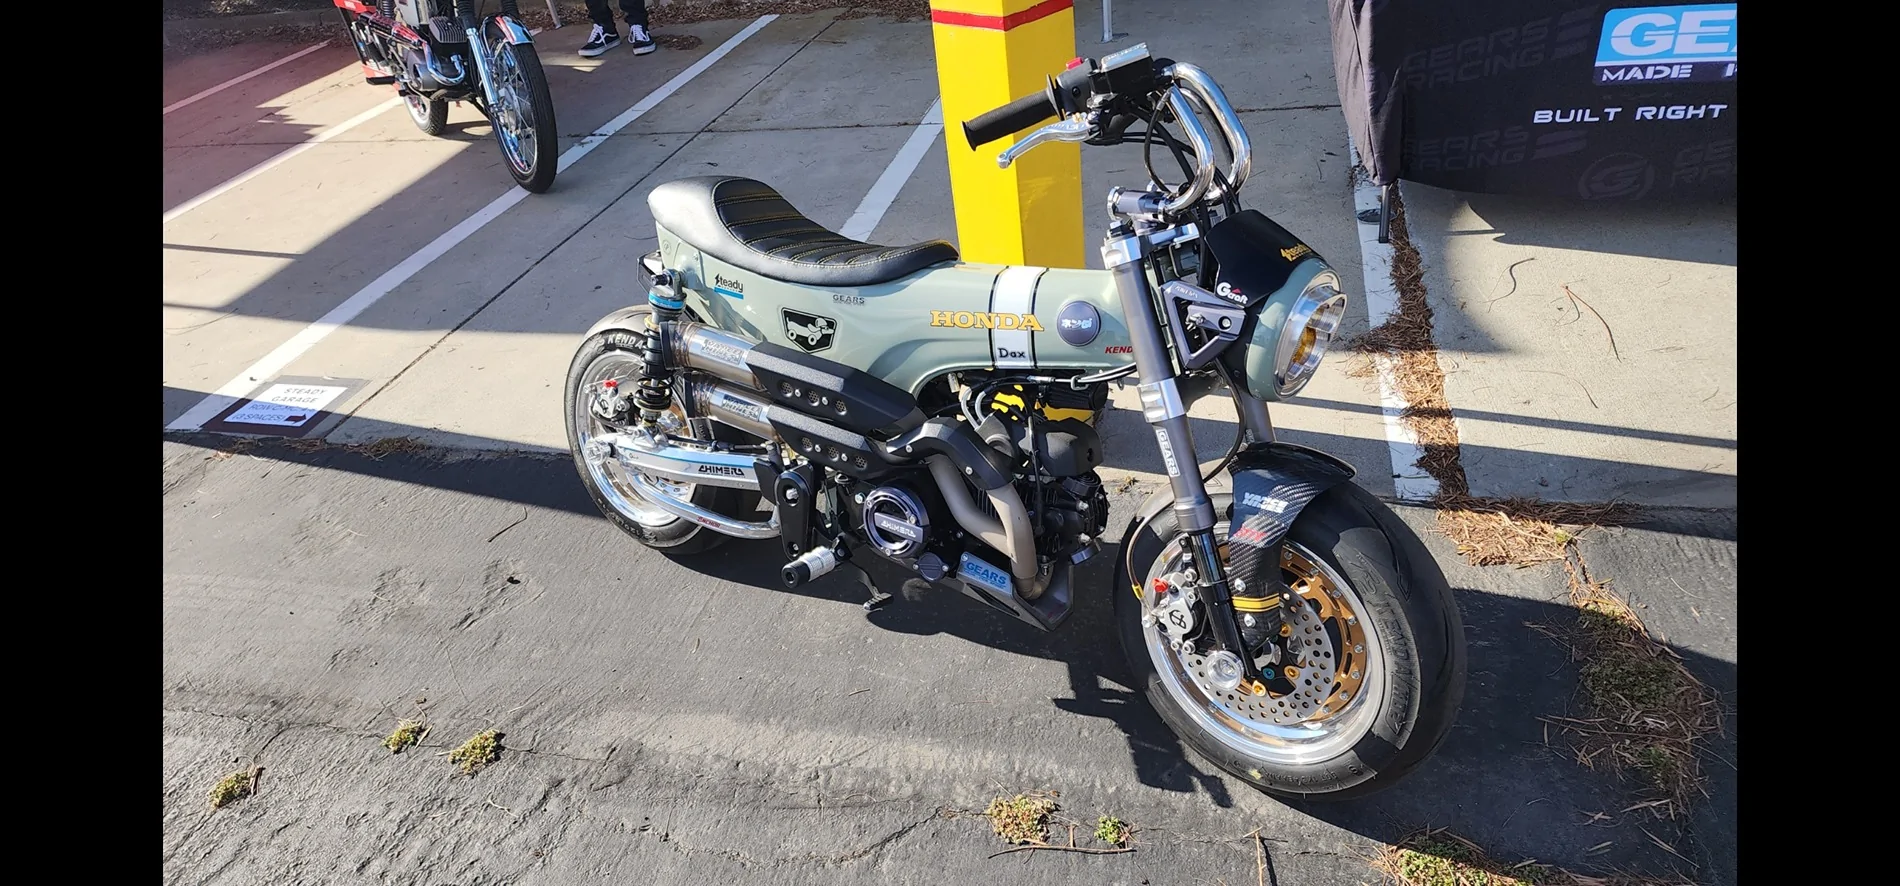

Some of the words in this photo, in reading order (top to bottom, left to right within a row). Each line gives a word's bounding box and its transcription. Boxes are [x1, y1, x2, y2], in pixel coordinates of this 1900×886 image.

[1610, 9, 1737, 56] GE
[1602, 64, 1693, 81] MADE
[1533, 107, 1622, 124] BUILT
[1635, 104, 1728, 121] RIGHT
[1405, 144, 1527, 172] ACING
[832, 294, 865, 304] GEARS
[929, 310, 1045, 332] HONDA
[607, 333, 644, 349] KENDA
[1105, 346, 1133, 354] KEND
[998, 347, 1026, 359] Dax
[1158, 430, 1179, 476] GEARS
[966, 562, 1007, 585] GEARS
